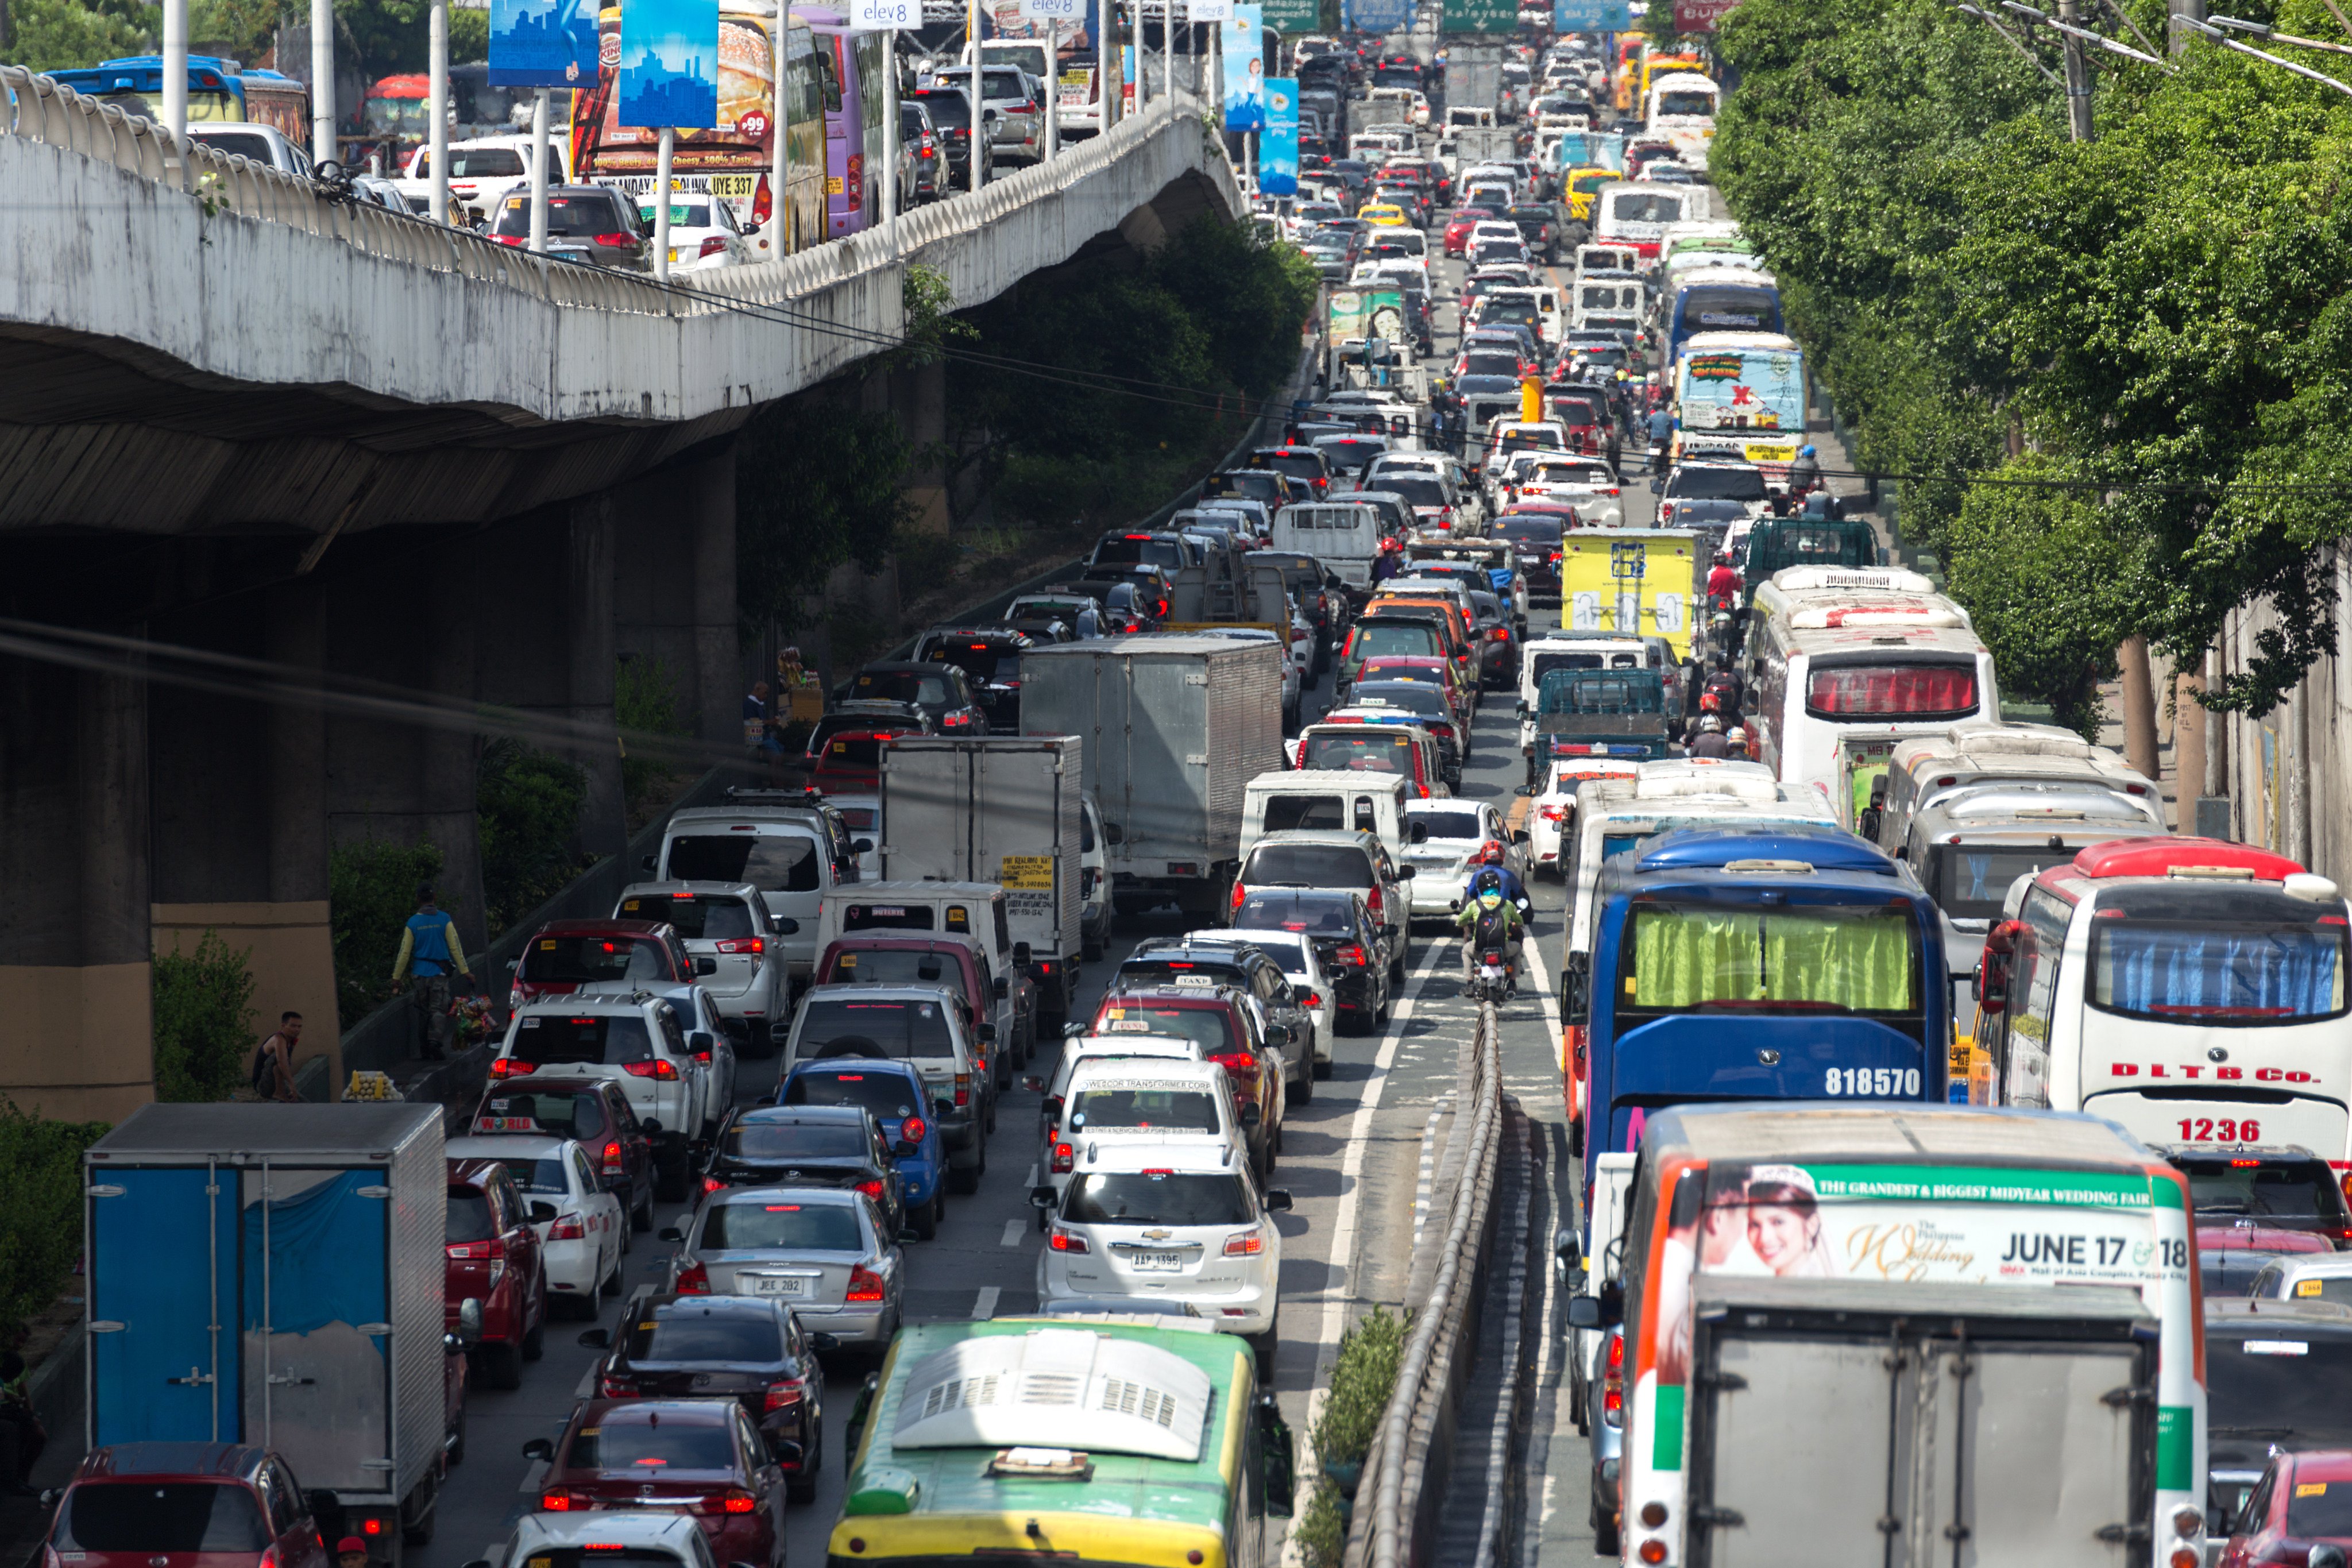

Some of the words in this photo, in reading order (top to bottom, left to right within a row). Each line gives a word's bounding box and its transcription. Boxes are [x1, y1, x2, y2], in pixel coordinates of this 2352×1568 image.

[864, 0, 906, 22] elev8
[599, 39, 621, 51] BURGE
[673, 156, 701, 165] Cheesy.
[704, 155, 728, 164] 500%
[731, 155, 754, 164] Tasty.
[713, 177, 731, 195] UYE
[735, 177, 752, 194] 337
[1825, 1067, 1920, 1096] 818570
[2177, 1118, 2261, 1142] 1236
[1820, 1180, 1847, 1194] THE
[1848, 1181, 1920, 1196] GRANDEST
[1921, 1184, 1931, 1197] &
[1933, 1184, 1988, 1199] BIGGEST
[1990, 1186, 2050, 1202] MIDYEAR
[2053, 1189, 2118, 1204] WEDDING
[2121, 1192, 2150, 1206] FAIR
[1919, 1220, 1936, 1229] The
[1846, 1223, 1975, 1273] Wedding
[2001, 1233, 2086, 1264] JUNE
[2096, 1236, 2126, 1265] 17
[2160, 1238, 2187, 1268] 18
[1135, 1254, 1152, 1265] AAP
